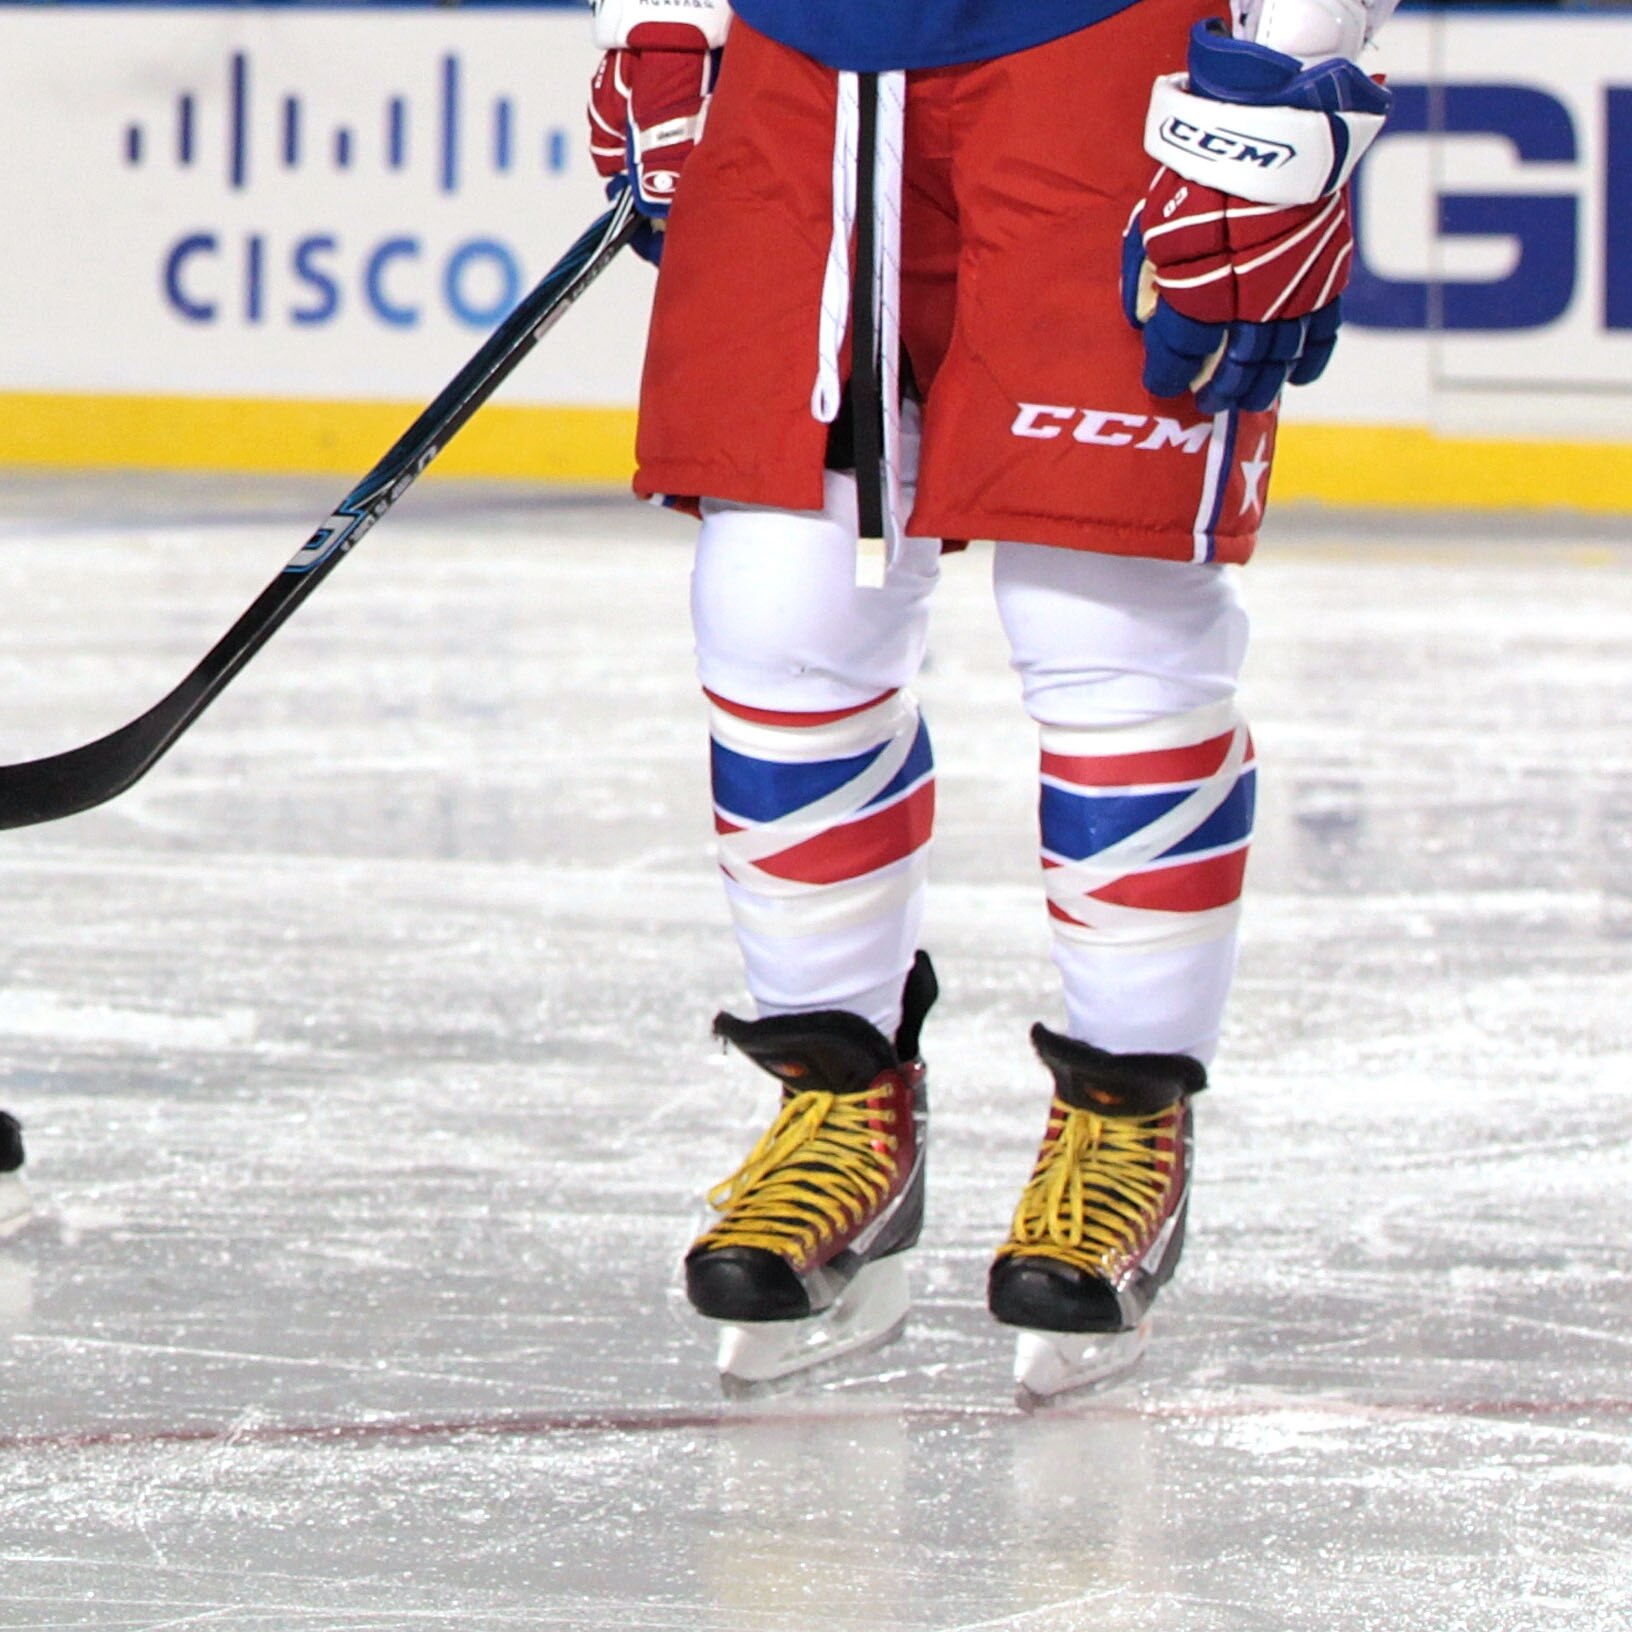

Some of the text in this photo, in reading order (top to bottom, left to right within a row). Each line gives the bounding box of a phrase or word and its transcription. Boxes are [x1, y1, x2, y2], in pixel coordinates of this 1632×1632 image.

[1169, 118, 1281, 168] CCM
[161, 232, 522, 329] CISCO
[1011, 403, 1214, 454] CCM
